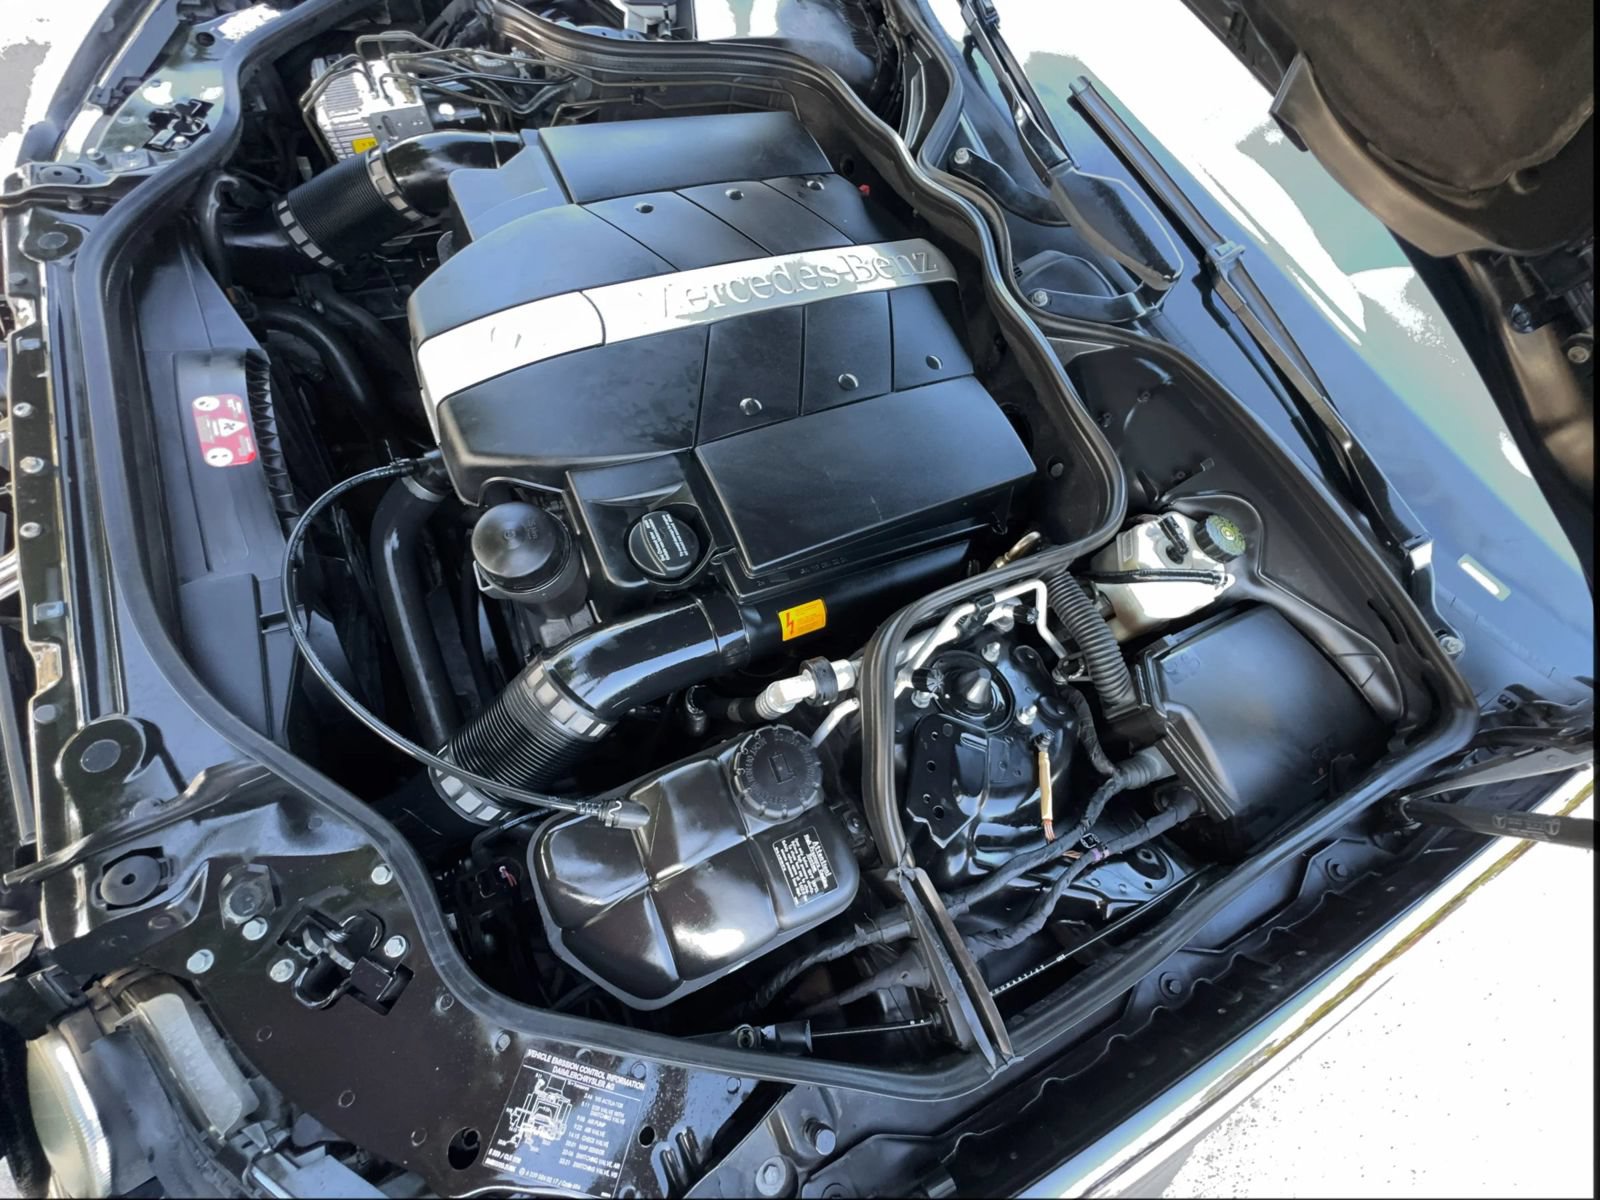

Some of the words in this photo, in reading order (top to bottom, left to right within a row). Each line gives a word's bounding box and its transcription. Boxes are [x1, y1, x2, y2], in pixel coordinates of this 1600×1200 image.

[528, 1050, 553, 1063] VEHICLE
[552, 1057, 580, 1071] EMISSION
[580, 1066, 607, 1080] CONTROL
[607, 1074, 646, 1091] INFORMATION
[552, 1066, 607, 1088] DAIMLERCHRYSLER
[606, 1082, 616, 1091] AG
